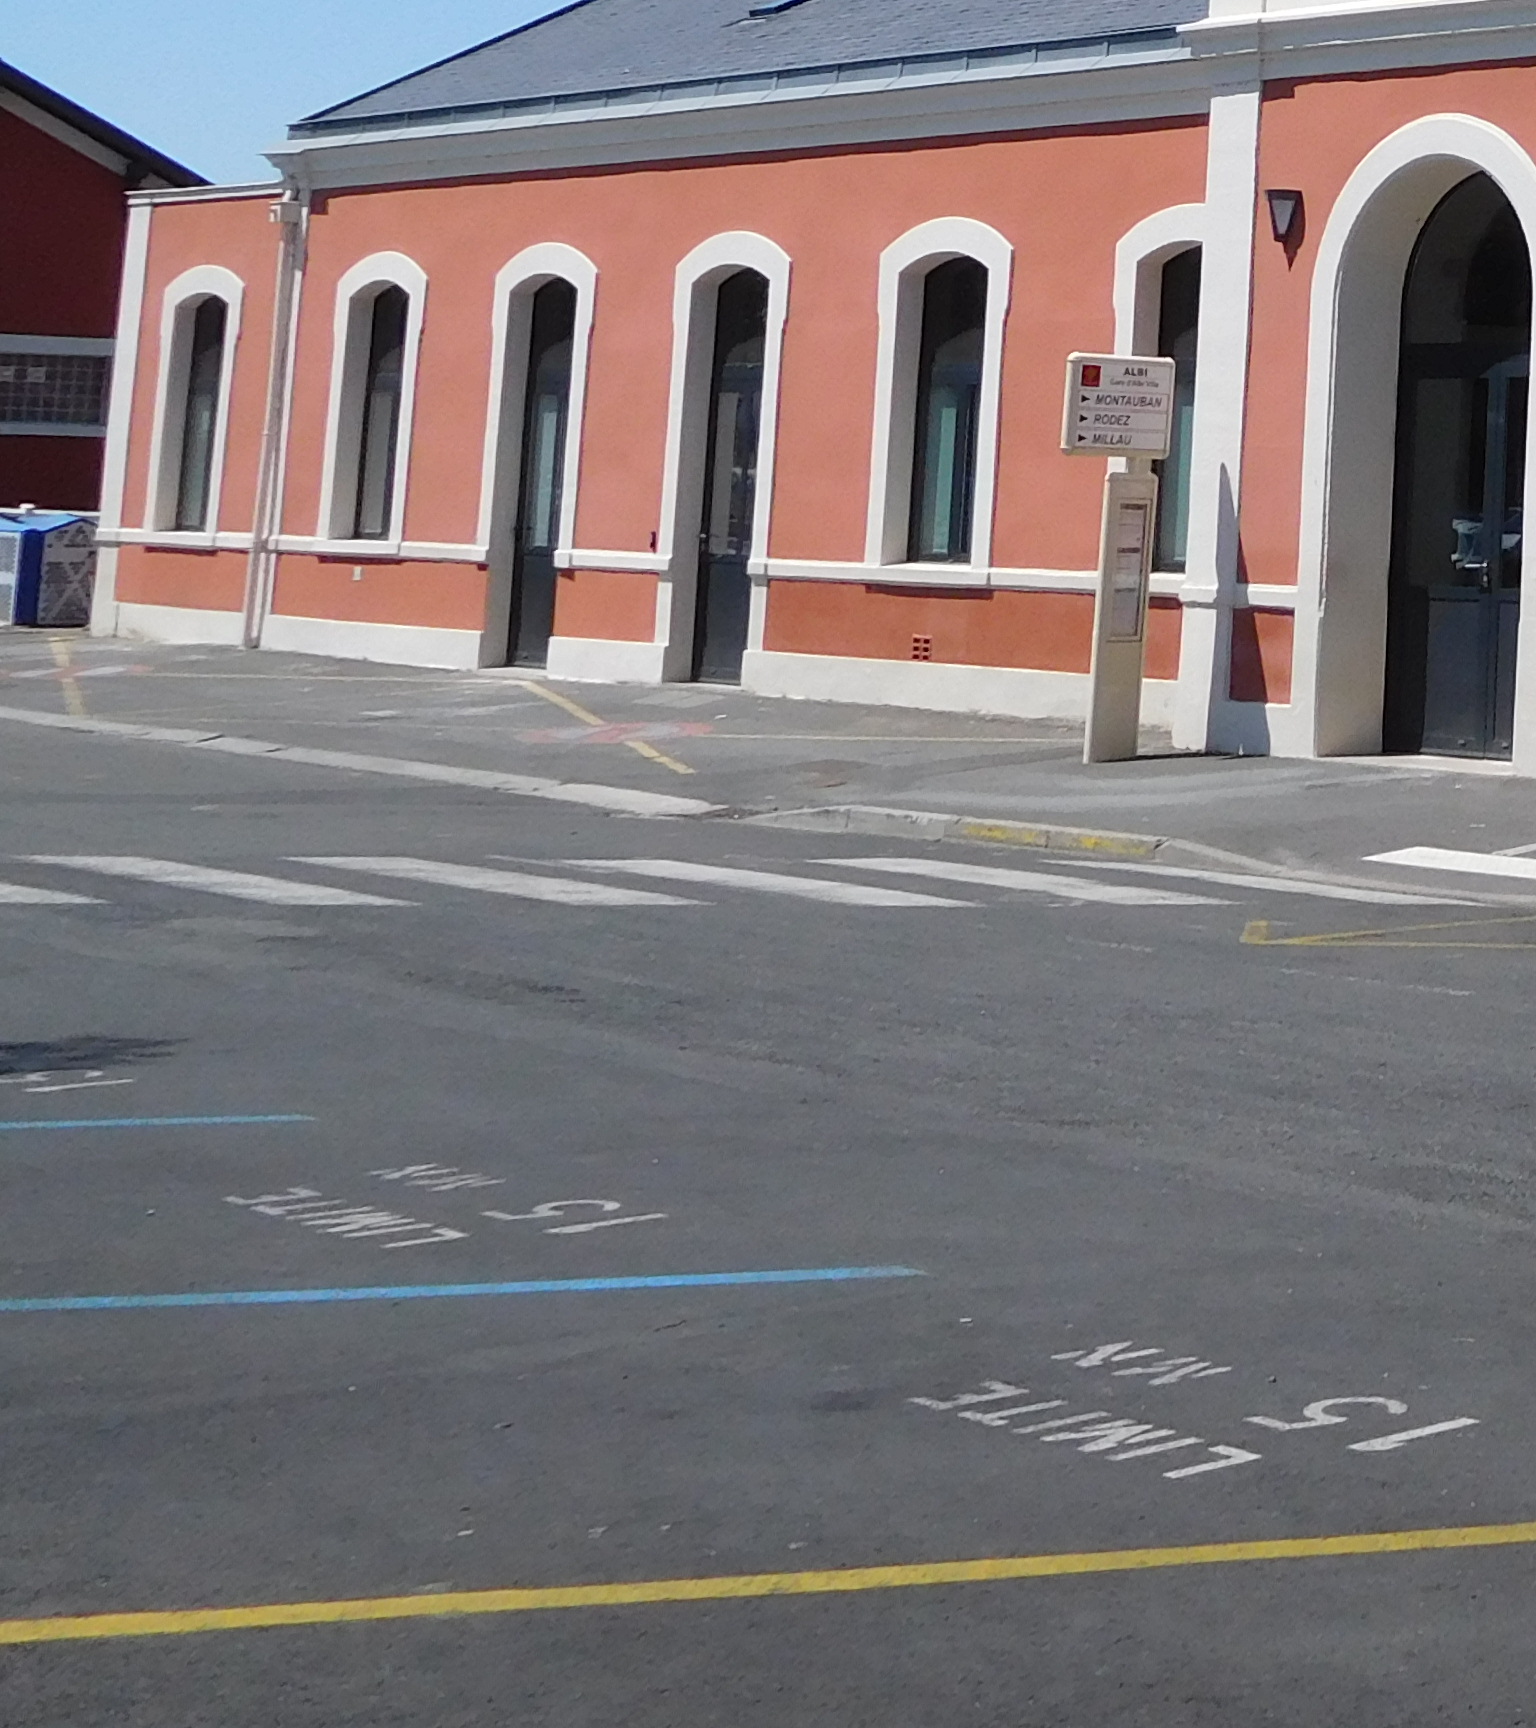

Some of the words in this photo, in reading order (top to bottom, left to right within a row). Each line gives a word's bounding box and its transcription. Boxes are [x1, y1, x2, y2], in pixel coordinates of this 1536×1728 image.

[1122, 366, 1148, 378] ALBI
[1095, 393, 1162, 407] MONTAUBAN
[1093, 414, 1131, 426] RODEZ
[1091, 434, 1132, 446] MILLAU
[222, 1187, 469, 1249] LIMITE
[481, 1199, 668, 1235] 15
[905, 1379, 1262, 1480] LIMITE
[1244, 1396, 1480, 1452] 15
